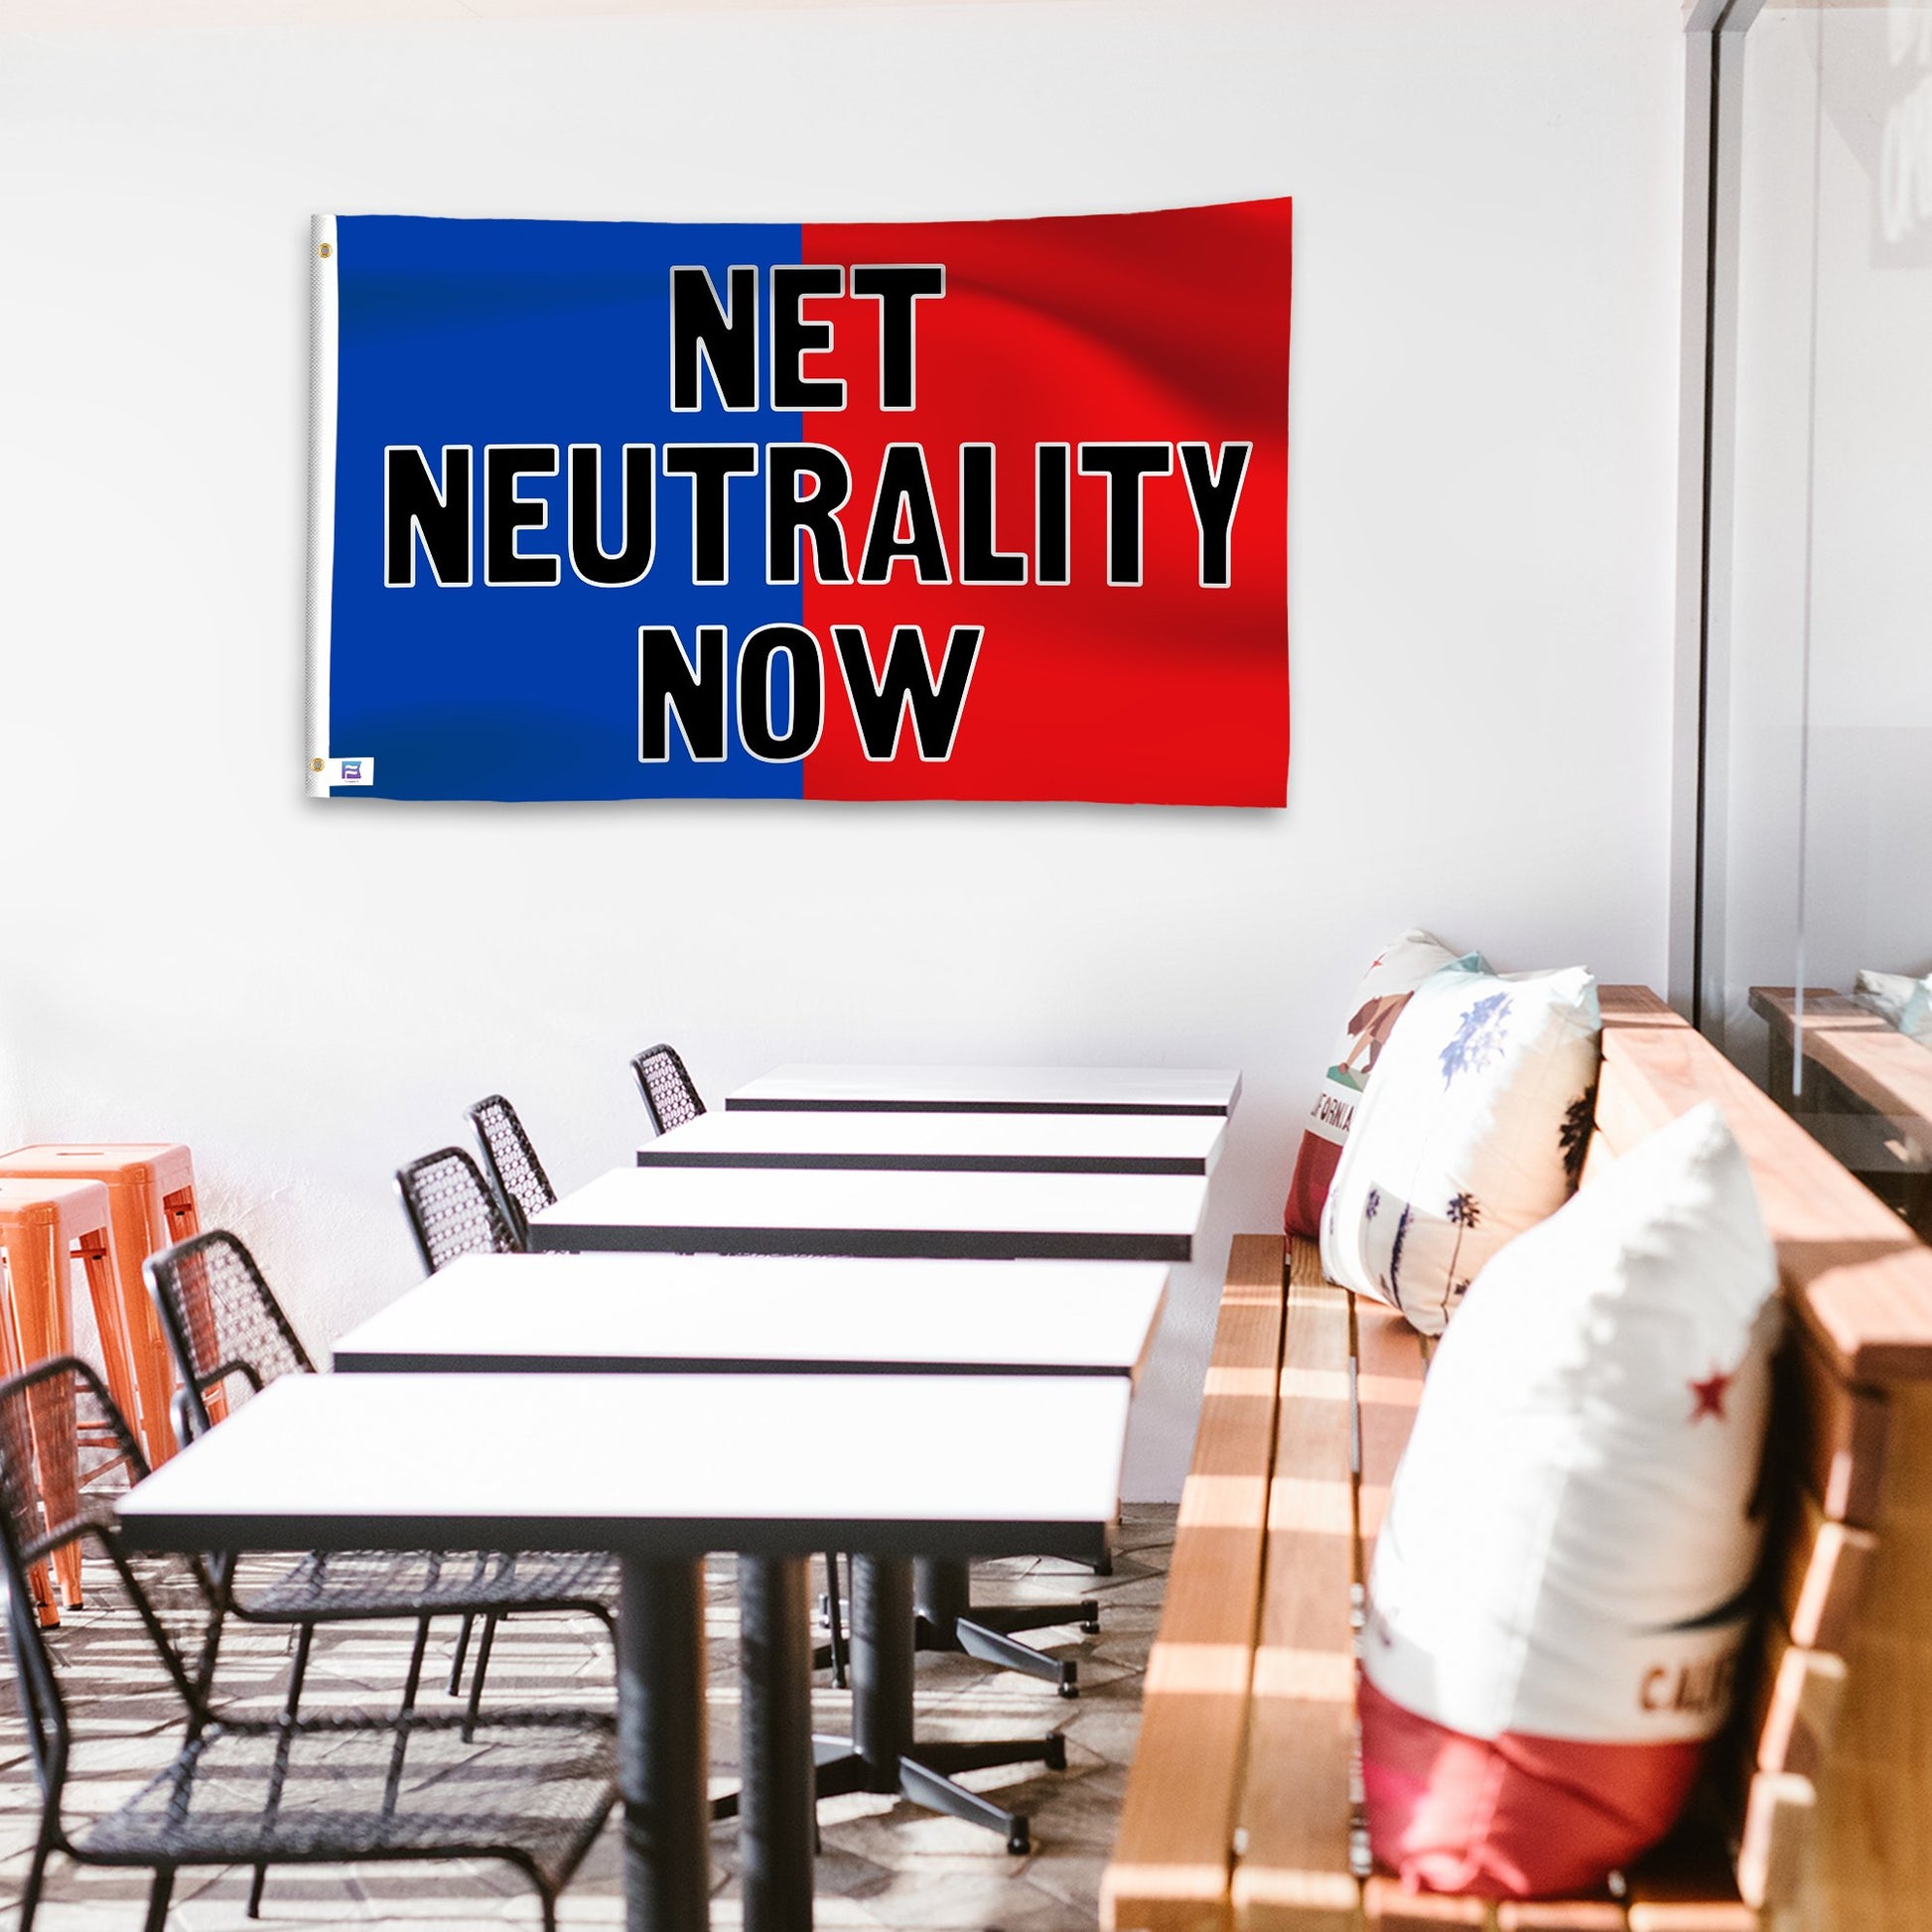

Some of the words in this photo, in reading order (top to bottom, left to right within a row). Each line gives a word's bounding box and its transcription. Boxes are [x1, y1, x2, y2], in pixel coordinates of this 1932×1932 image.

[669, 263, 946, 413] NET
[383, 441, 1253, 589] NEUTRALITY
[637, 623, 985, 764] NOW
